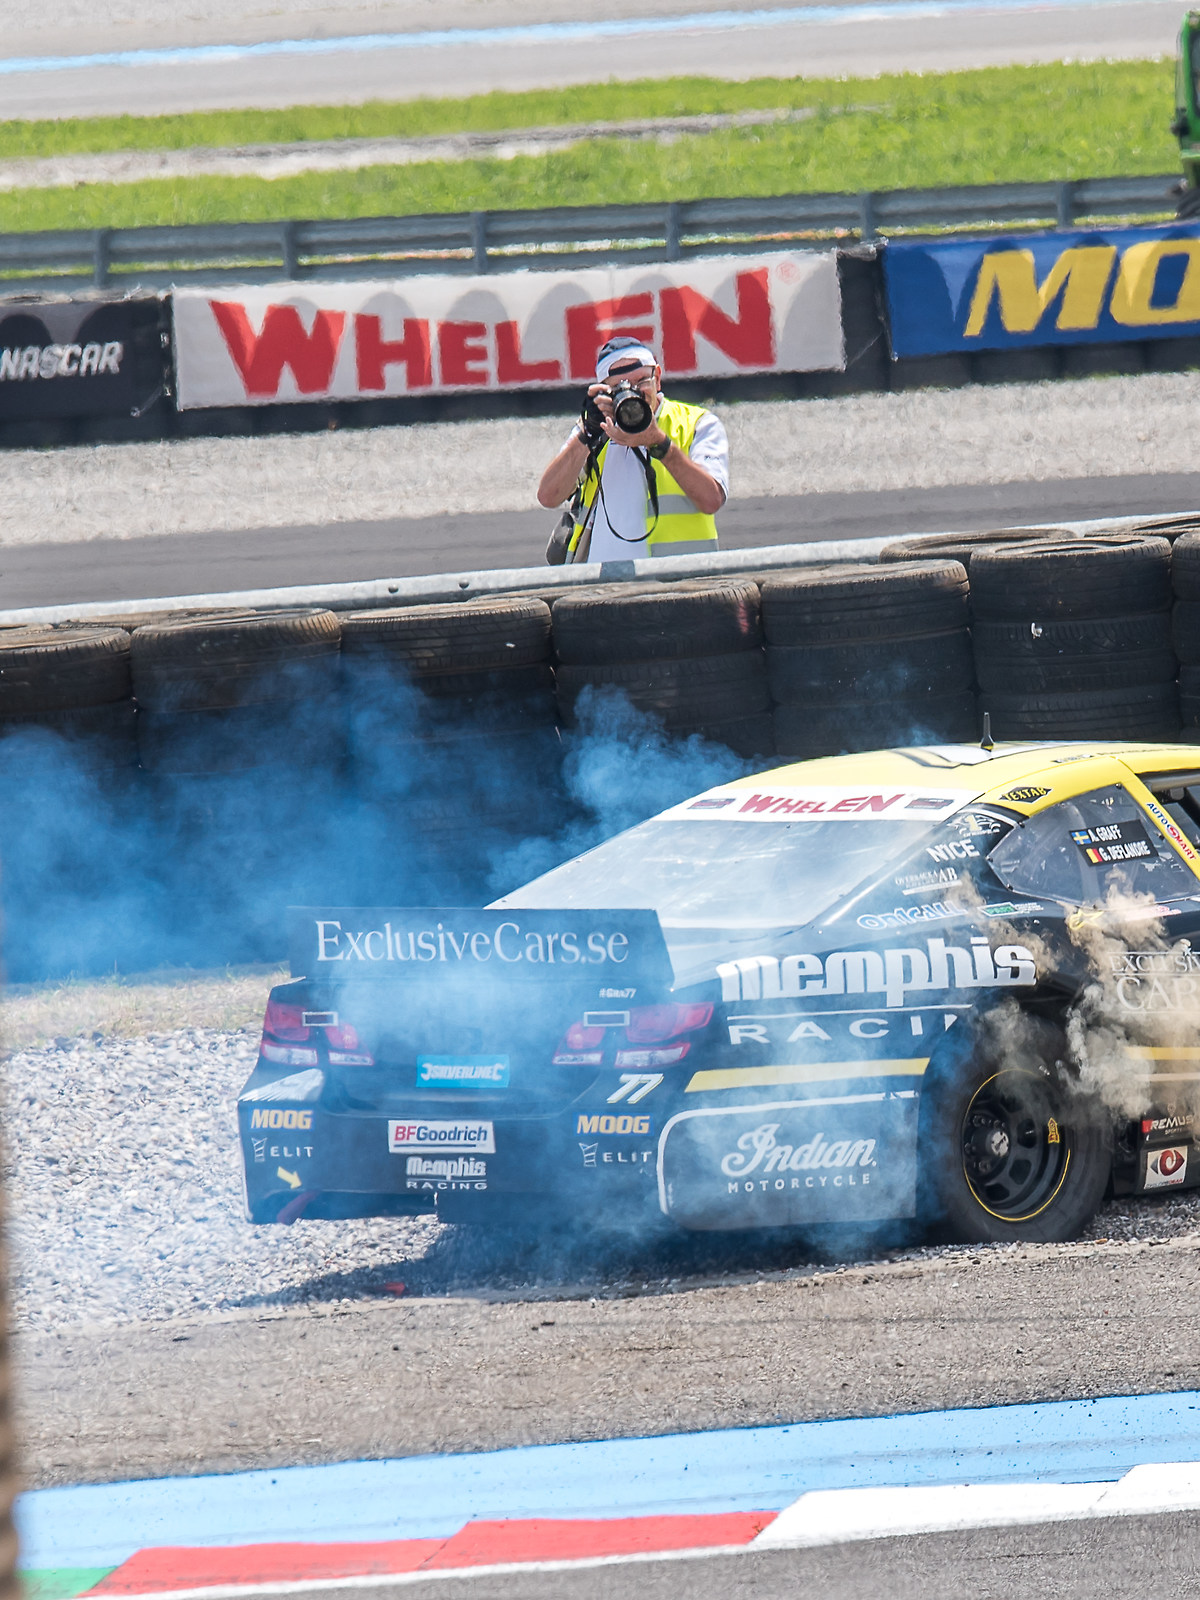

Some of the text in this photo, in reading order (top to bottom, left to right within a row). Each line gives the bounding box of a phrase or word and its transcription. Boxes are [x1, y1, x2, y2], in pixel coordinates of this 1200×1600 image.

[209, 265, 777, 398] WHELEN
[0, 341, 124, 381] NASCAR
[738, 794, 906, 814] WHELEN
[1004, 787, 1047, 802] TEXTAB
[926, 839, 980, 863] NICE
[315, 920, 629, 964] ExclusiveCars.se
[606, 1073, 664, 1104] 77
[251, 1109, 314, 1130] MOOG
[577, 1115, 651, 1134] MOOG
[1150, 1115, 1194, 1131] REMUS
[394, 1126, 488, 1141] BFGoodrich
[270, 1146, 314, 1158] ELIT
[603, 1151, 653, 1163] ELIT
[406, 1181, 488, 1190] RACING
[727, 1172, 870, 1194] MOTORCYCLE
